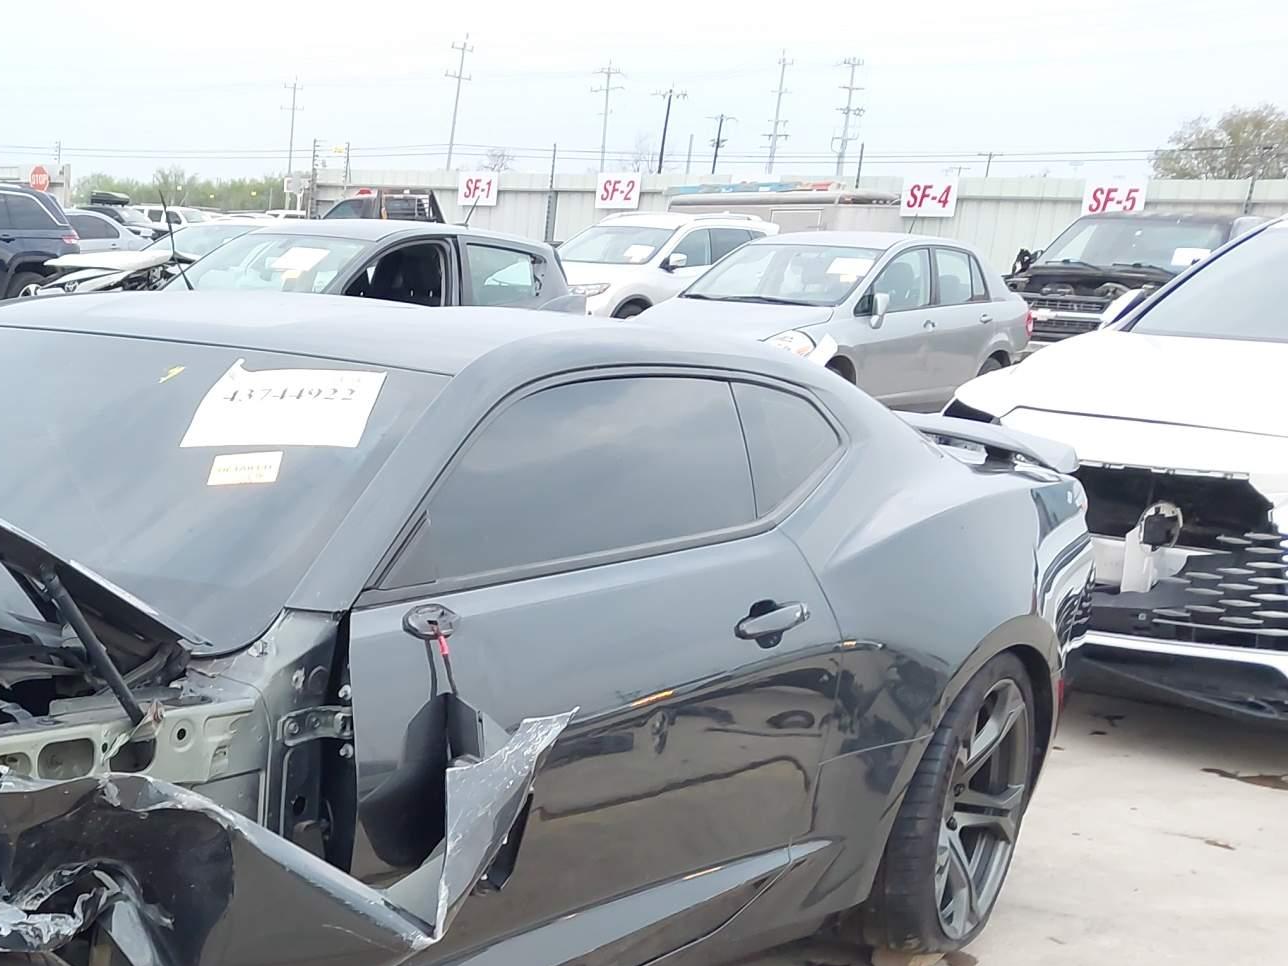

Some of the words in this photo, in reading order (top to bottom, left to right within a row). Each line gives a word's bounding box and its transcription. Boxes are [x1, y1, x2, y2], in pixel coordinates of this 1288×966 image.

[463, 178, 492, 199] SF-1
[600, 179, 635, 201] SF-2
[906, 184, 952, 208] SF-4
[1088, 187, 1140, 212] SF-5
[223, 387, 357, 402] 43744922
